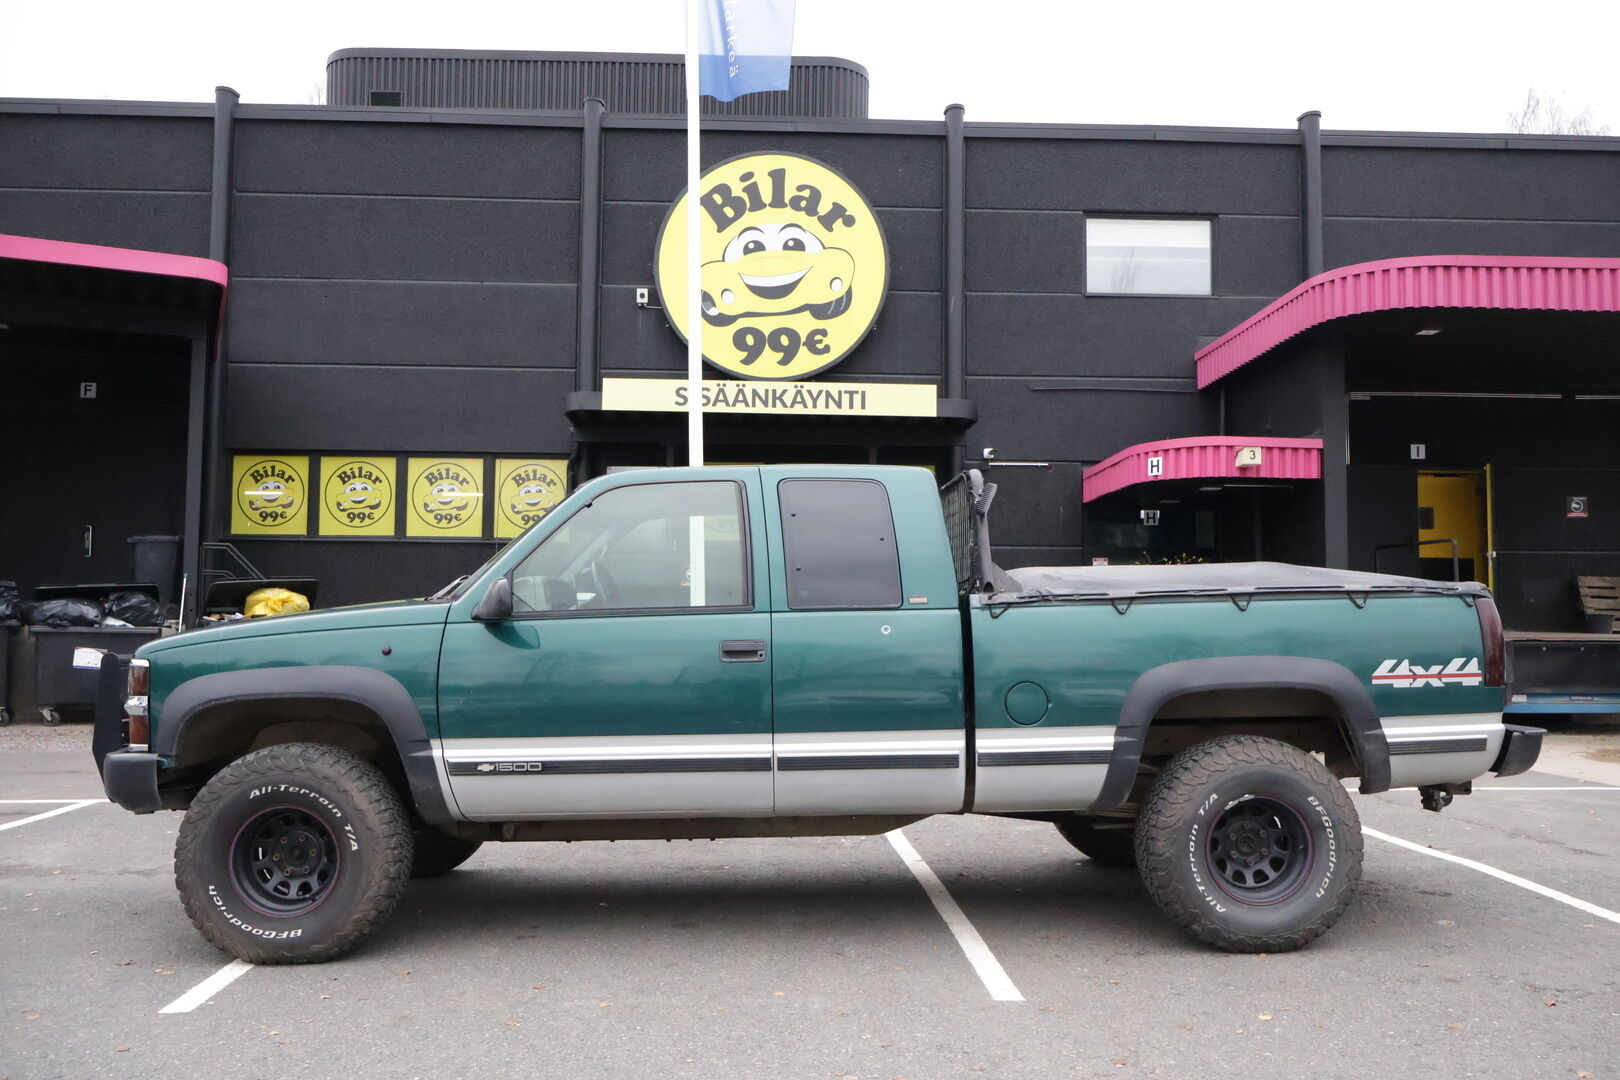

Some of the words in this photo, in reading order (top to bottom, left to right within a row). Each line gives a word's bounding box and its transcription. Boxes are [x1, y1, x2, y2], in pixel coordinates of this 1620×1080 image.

[700, 167, 856, 233] Bilar
[732, 326, 831, 366] 99€
[84, 384, 93, 396] F
[674, 383, 867, 410] SSÄÄNKÄYNTI
[1249, 449, 1256, 460] 3
[249, 465, 296, 484] Bilar
[336, 466, 383, 485] Bilar
[1150, 459, 1160, 473] H
[424, 468, 470, 486] Bilar
[511, 469, 557, 488] Bilar
[258, 510, 287, 522] 99€
[346, 511, 375, 523] 99€
[433, 513, 462, 524] 99€
[1145, 512, 1157, 524] H
[1371, 657, 1483, 688] 4x4
[496, 762, 541, 772] 1500
[344, 824, 358, 851] T/A
[1307, 796, 1337, 898] BFGoodrich
[208, 885, 302, 939] BFGoodrich
